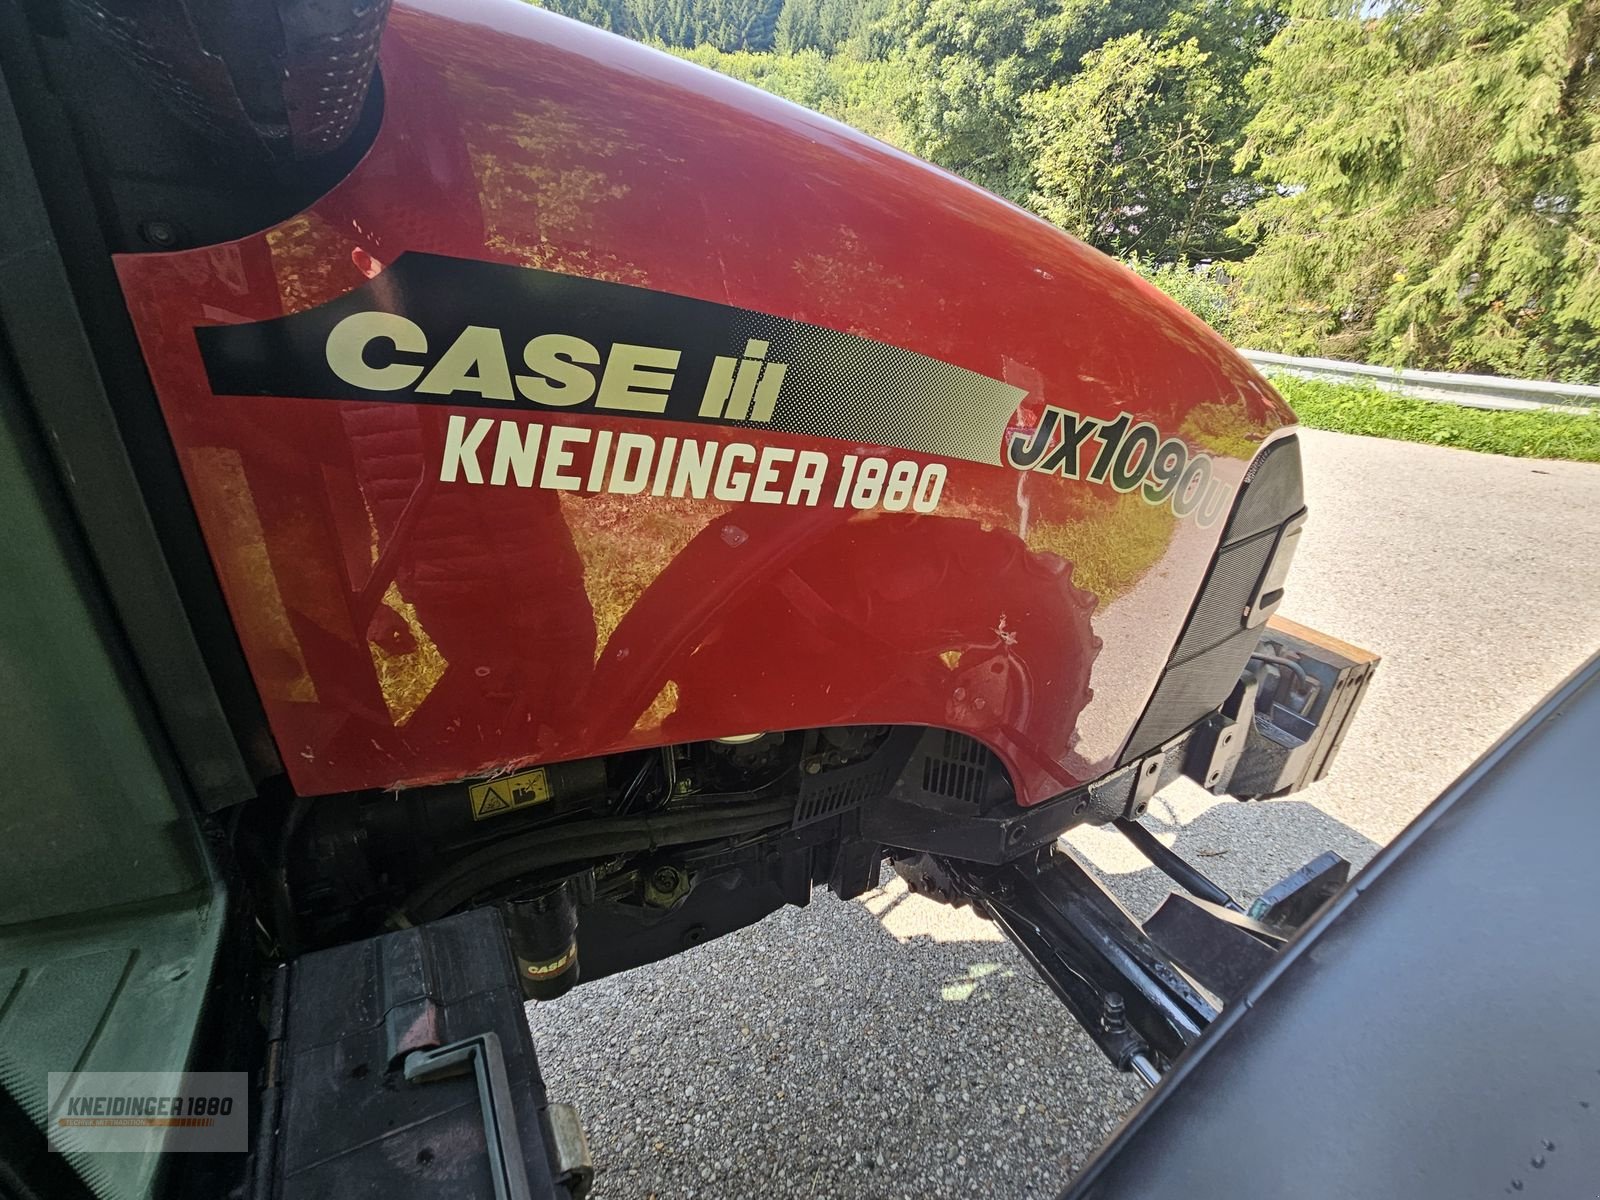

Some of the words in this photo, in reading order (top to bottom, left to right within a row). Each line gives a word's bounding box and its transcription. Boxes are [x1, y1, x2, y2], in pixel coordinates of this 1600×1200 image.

[325, 310, 681, 413] CASE
[439, 414, 829, 508] KNEIDINGER
[833, 454, 948, 513] 1880
[1006, 404, 1236, 529] JX1090U
[528, 955, 568, 974] CASE
